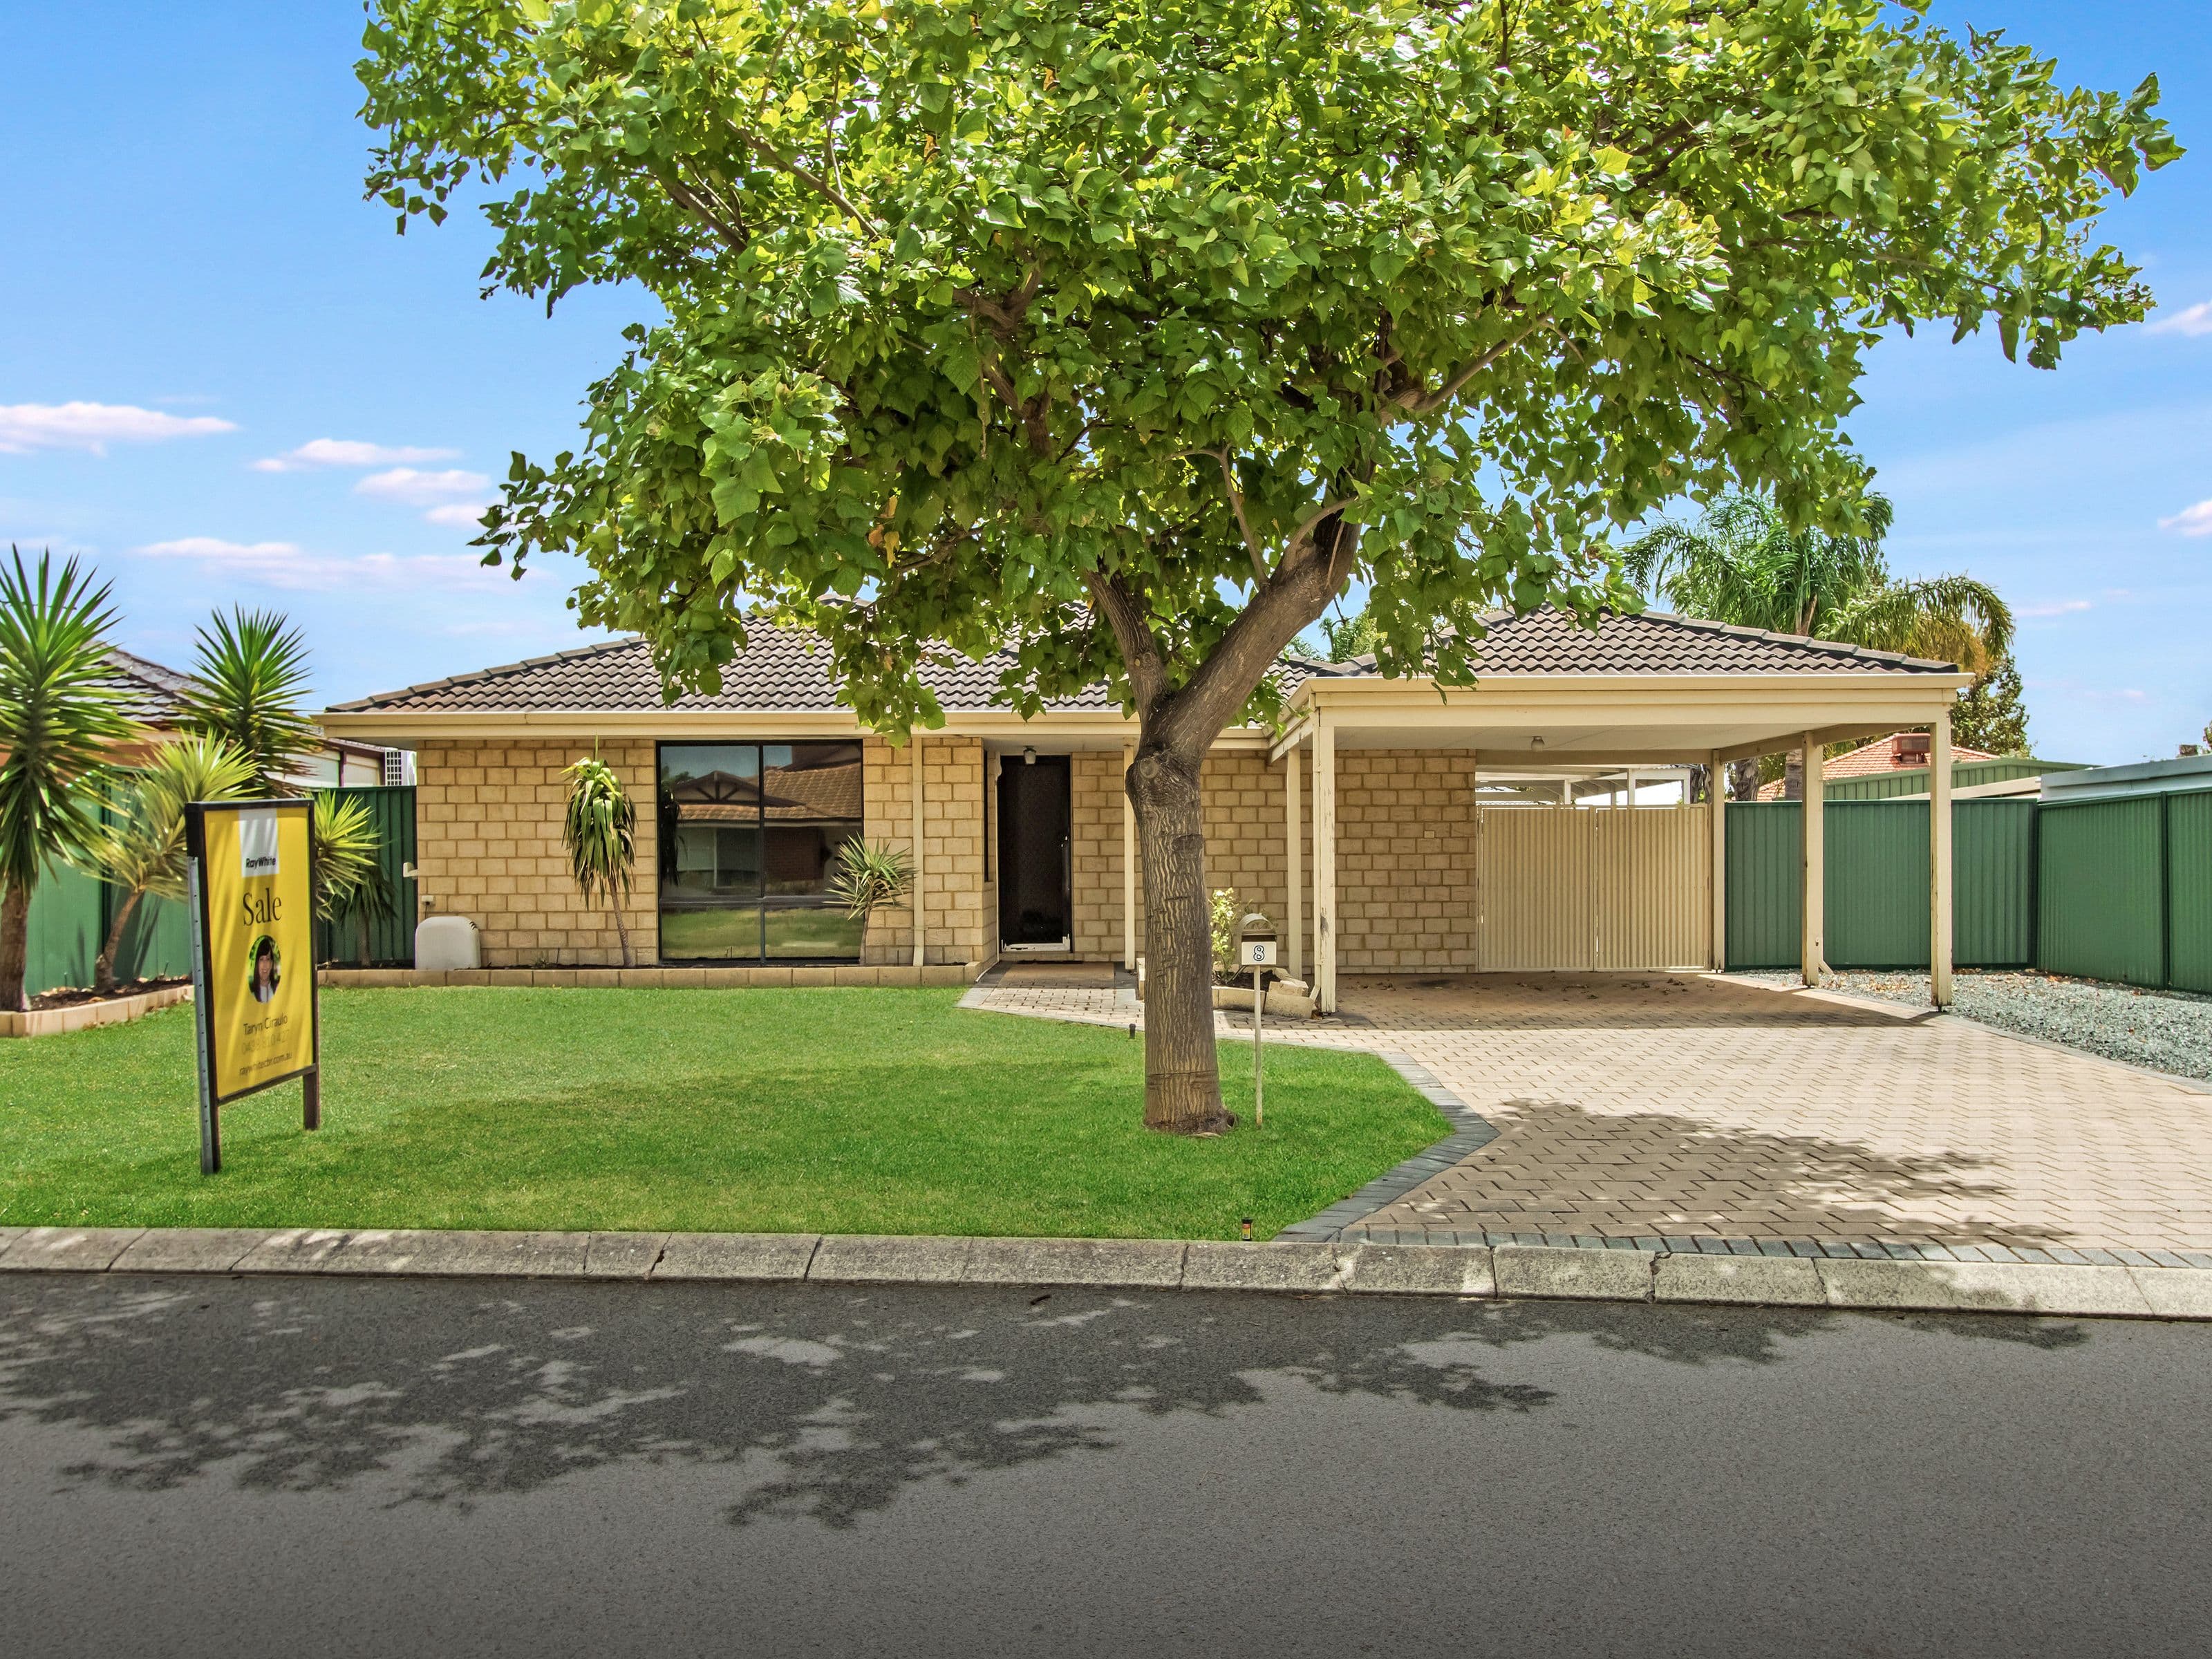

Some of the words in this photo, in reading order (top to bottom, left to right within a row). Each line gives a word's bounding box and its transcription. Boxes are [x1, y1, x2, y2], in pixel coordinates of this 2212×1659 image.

[243, 888, 282, 926] Sale
[1253, 945, 1265, 961] 8
[243, 1023, 263, 1035] Taryn
[265, 1013, 288, 1029] Ciraulo
